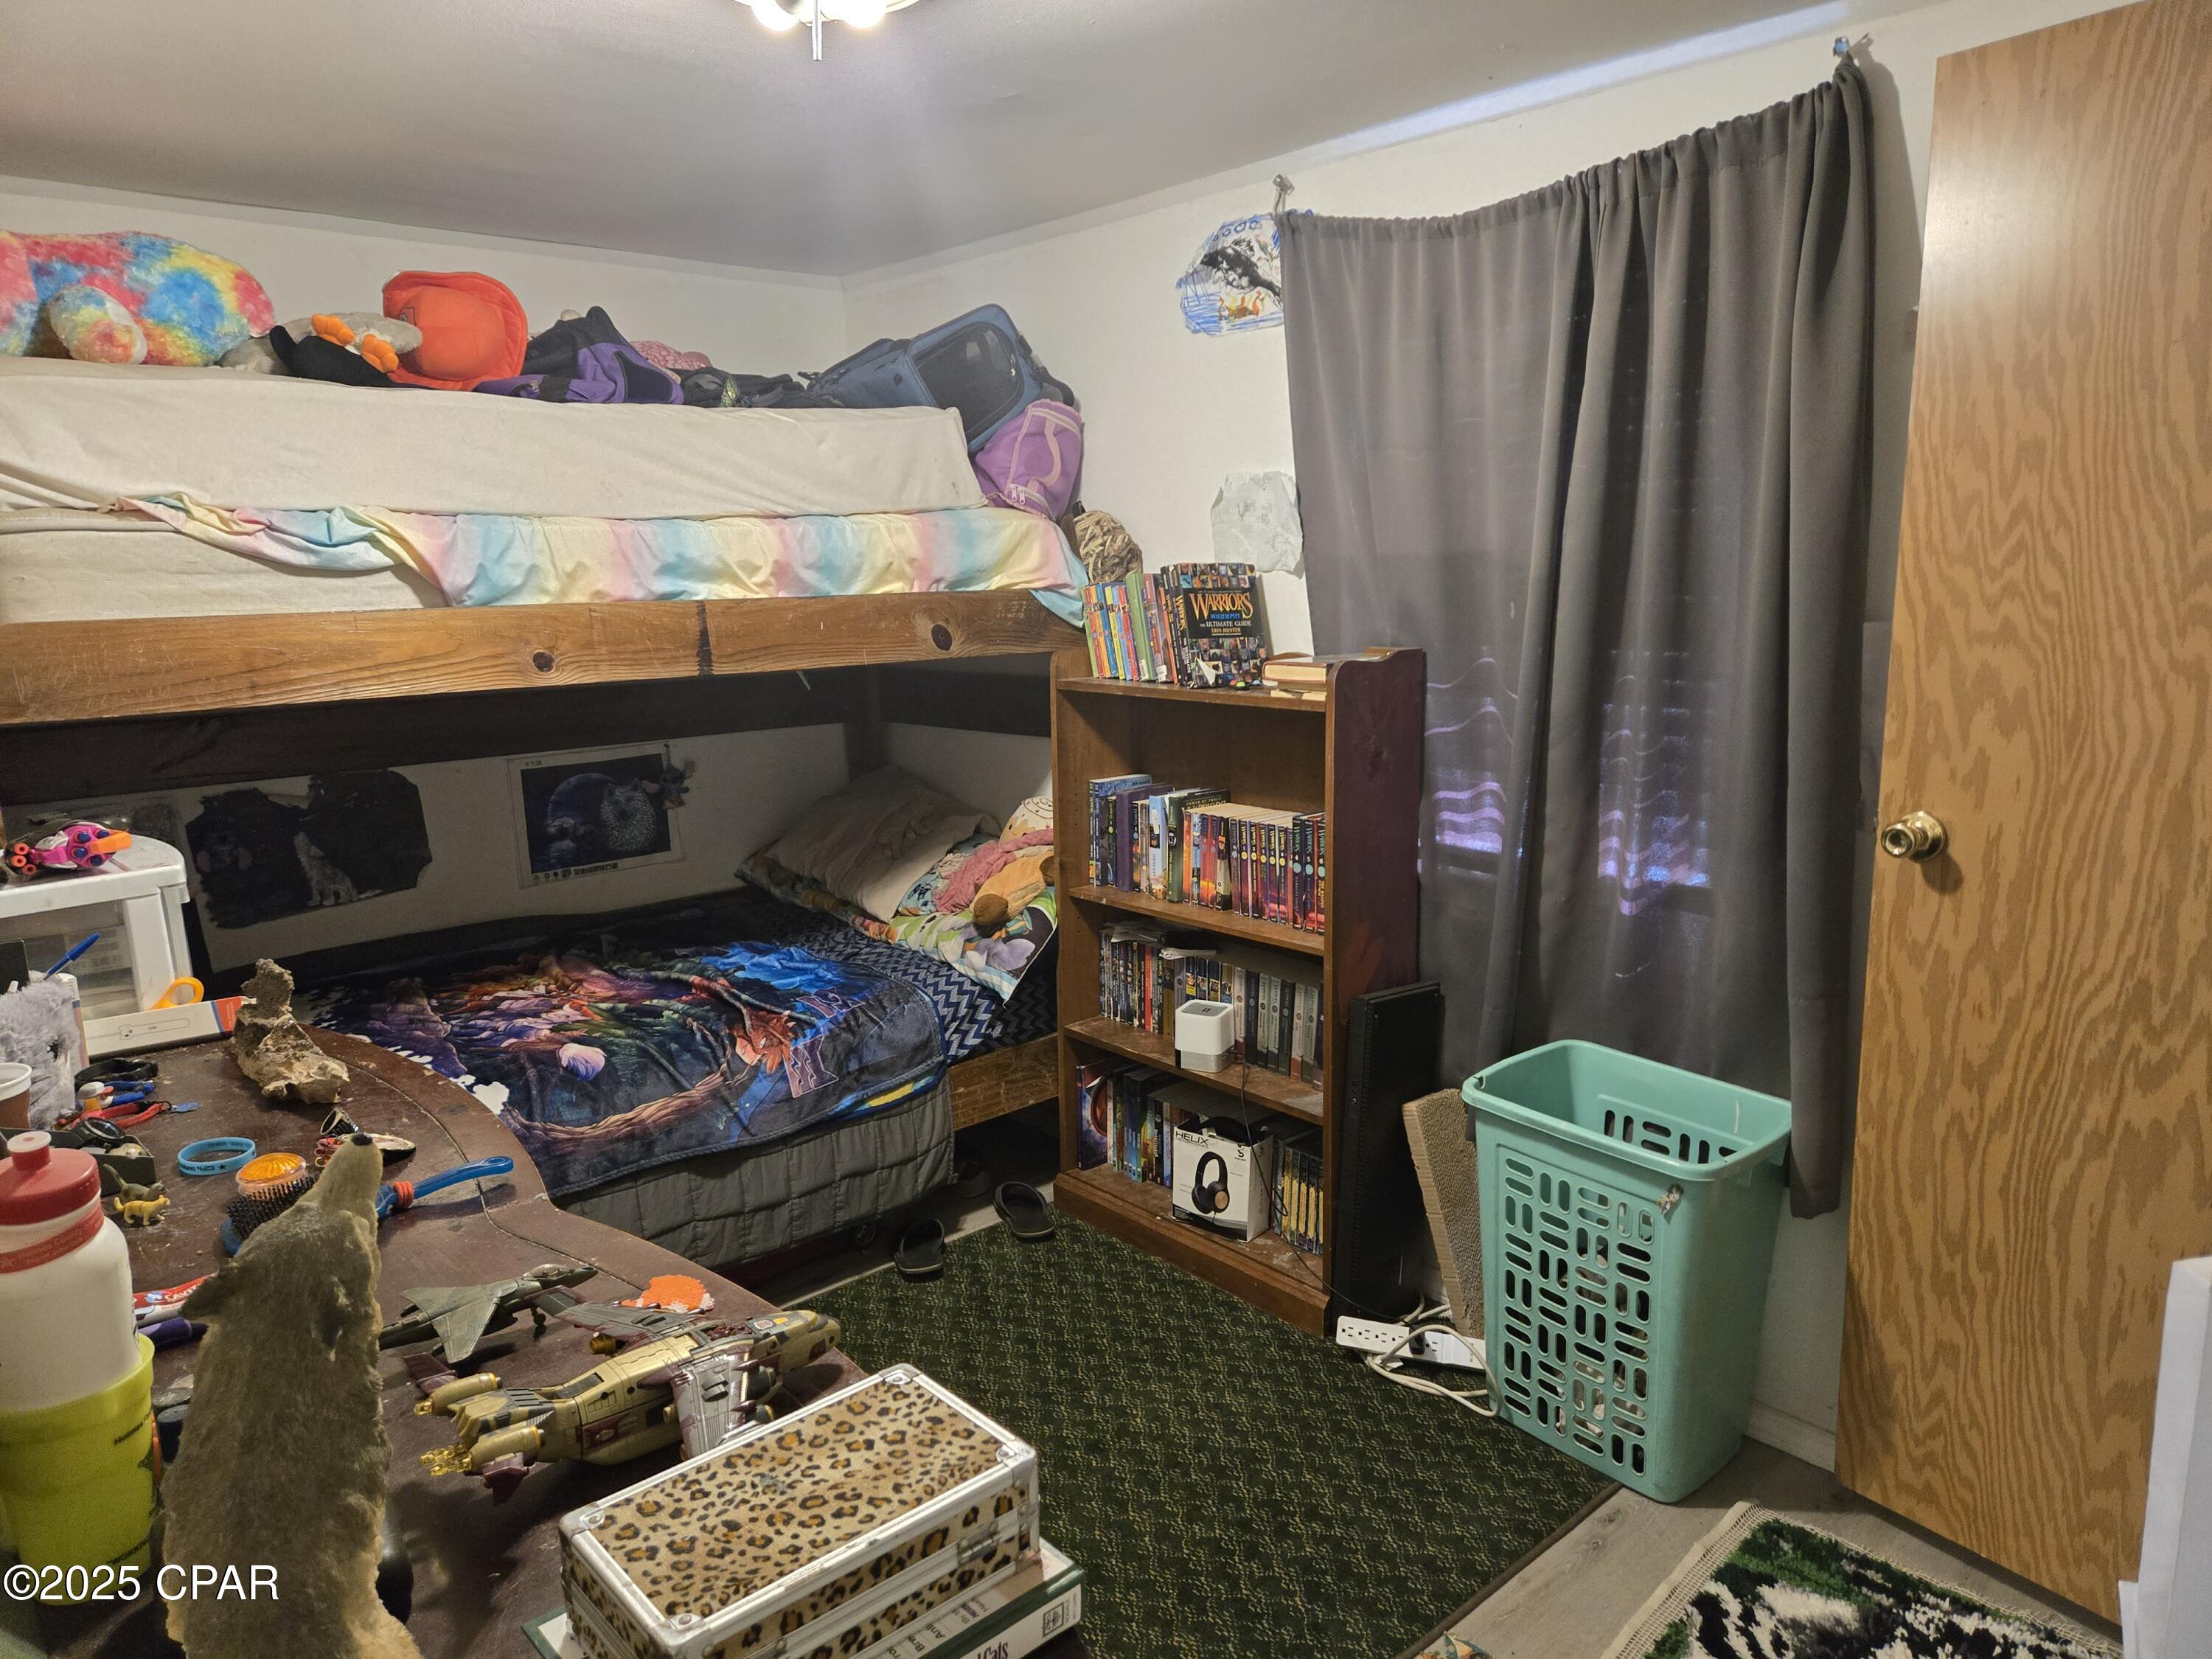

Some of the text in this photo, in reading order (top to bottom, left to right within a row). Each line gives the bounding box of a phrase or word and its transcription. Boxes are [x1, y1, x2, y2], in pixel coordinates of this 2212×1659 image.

[1175, 594, 1186, 630] WARRIORS
[1189, 591, 1253, 620] WARRIORS
[1175, 1130, 1208, 1146] HELIX
[164, 1284, 200, 1302] CAVIT
